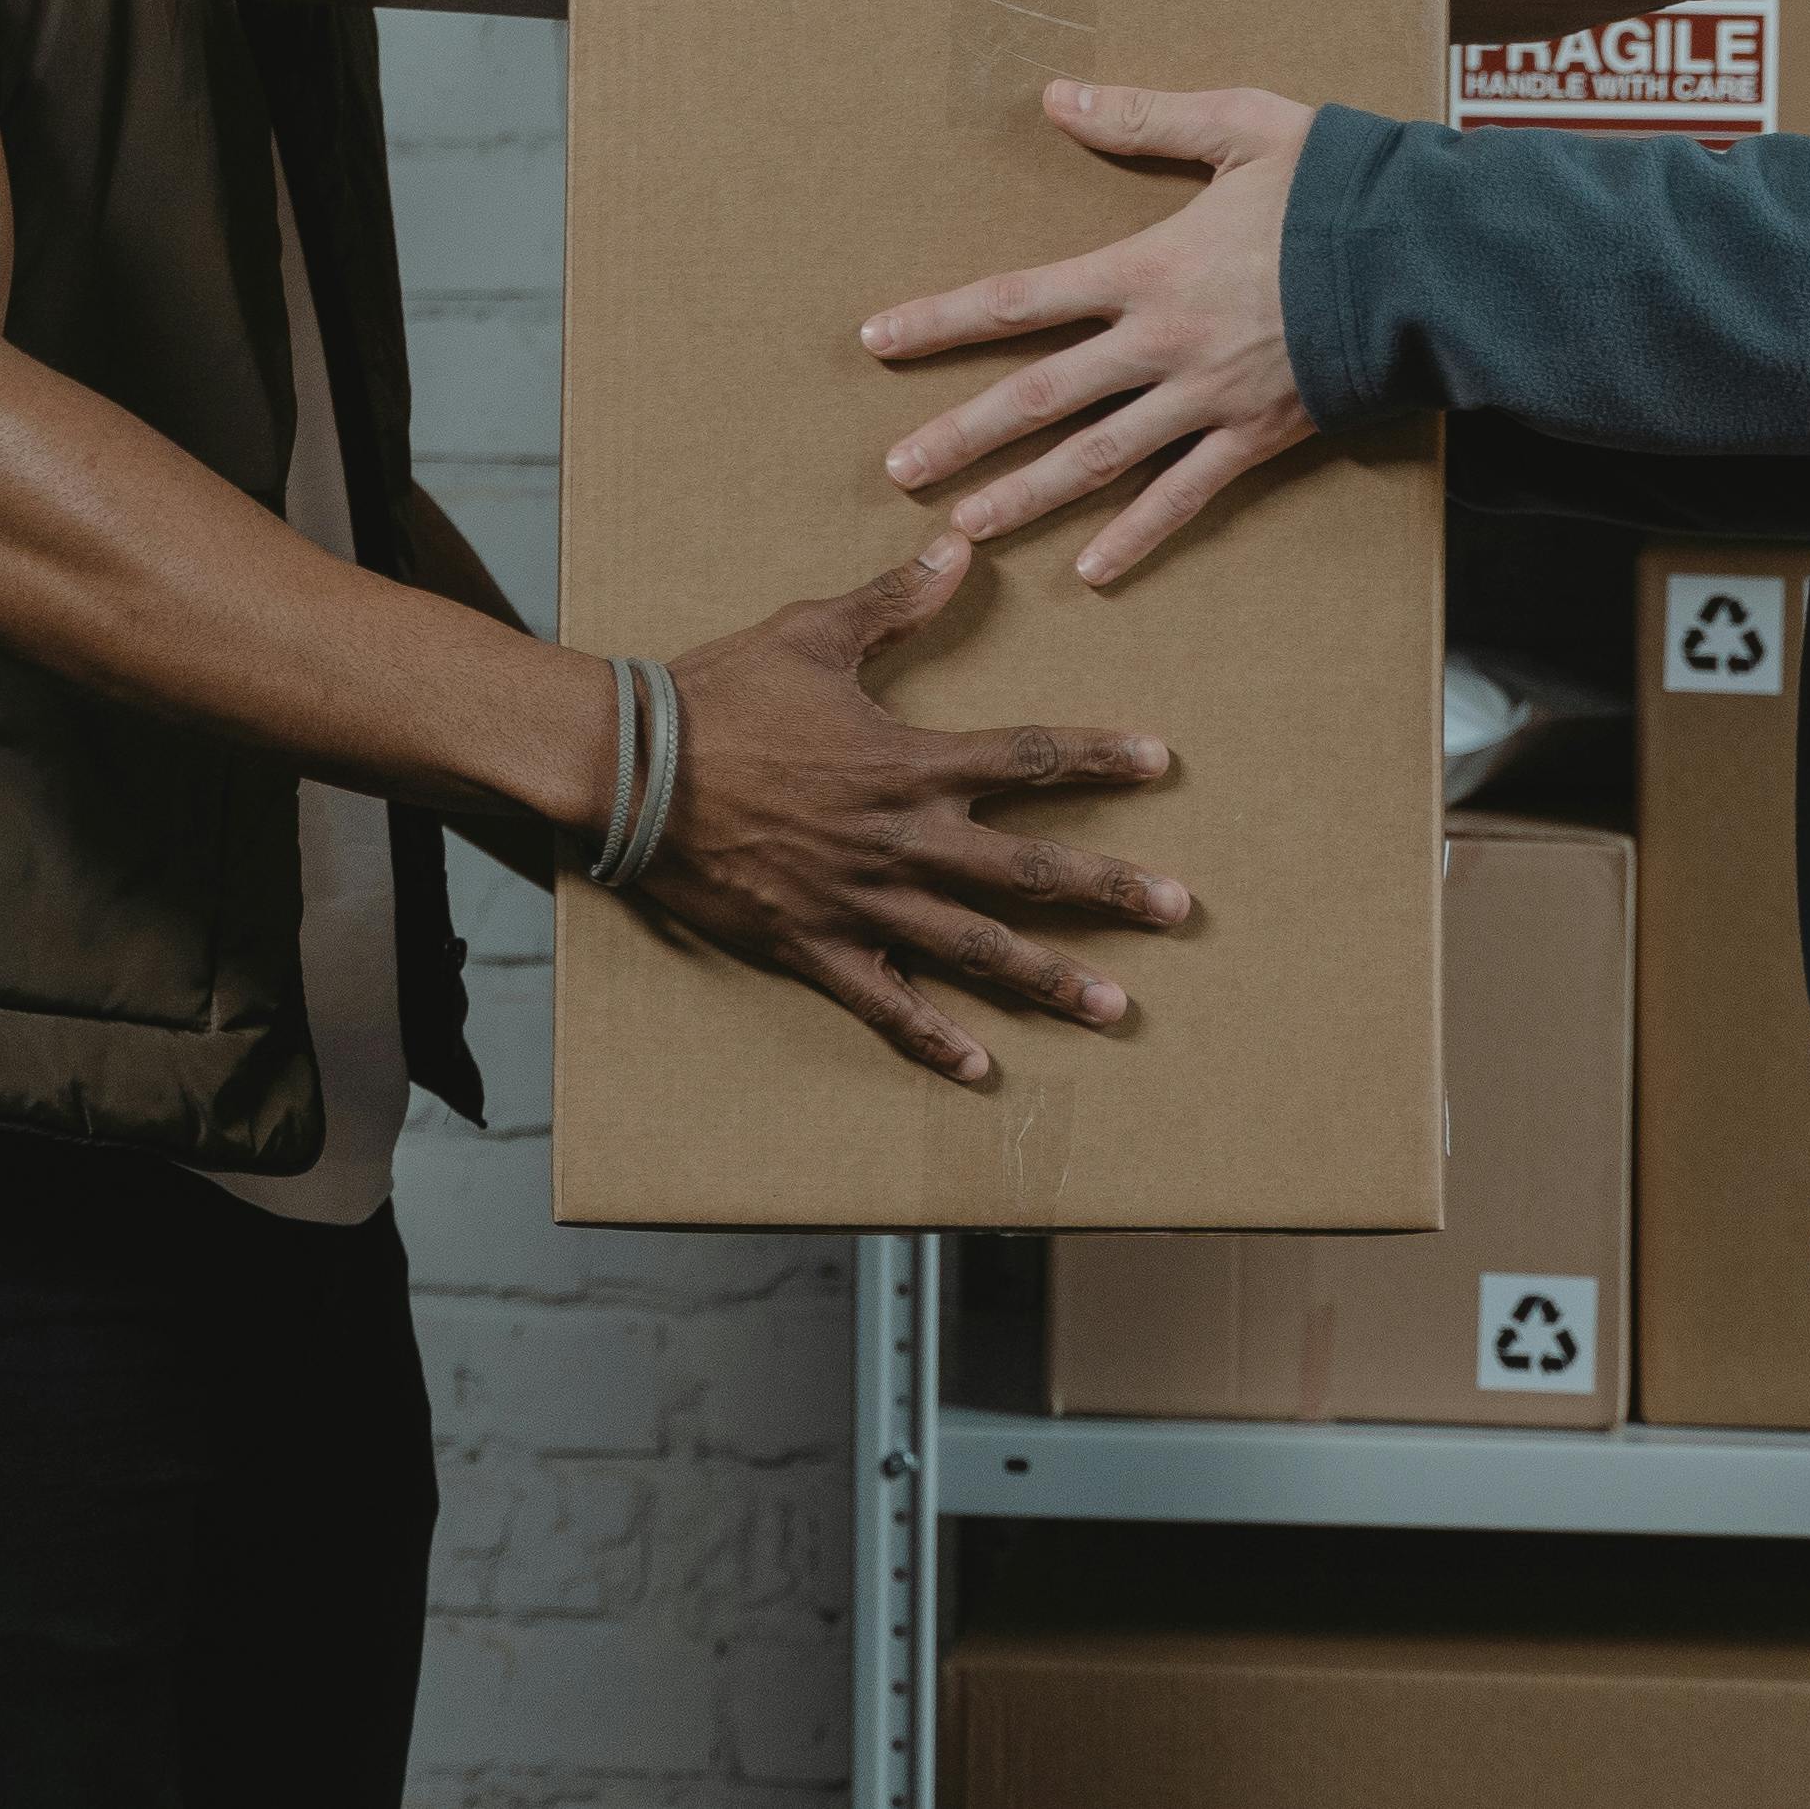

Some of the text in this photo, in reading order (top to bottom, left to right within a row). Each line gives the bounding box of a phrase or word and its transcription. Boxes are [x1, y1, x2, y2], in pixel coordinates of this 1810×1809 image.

[1465, 70, 1758, 102] HANDLE WITH CARE
